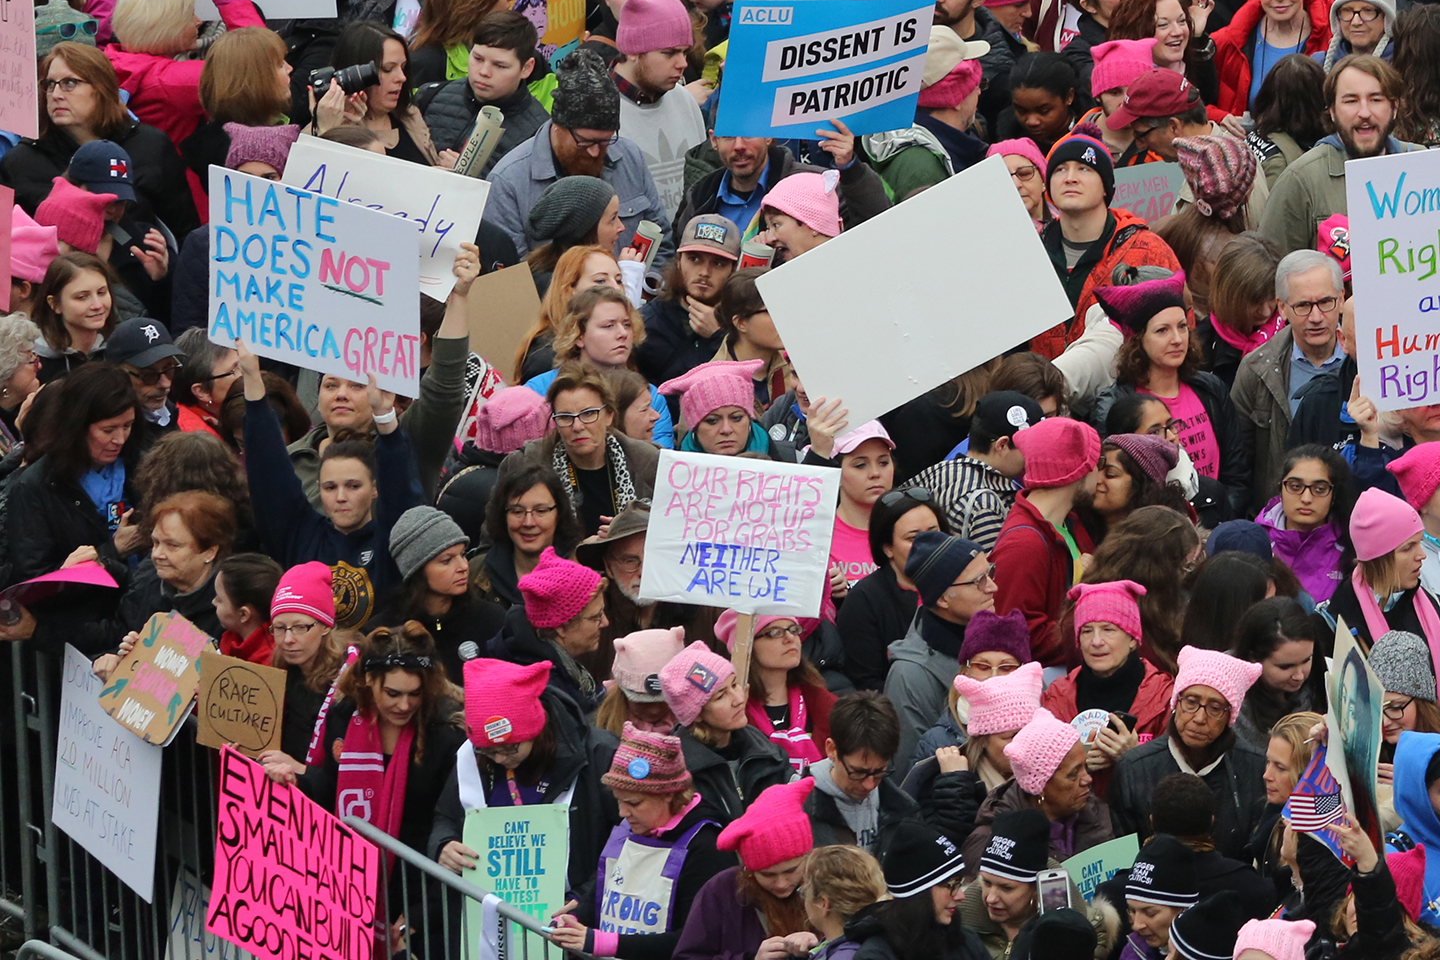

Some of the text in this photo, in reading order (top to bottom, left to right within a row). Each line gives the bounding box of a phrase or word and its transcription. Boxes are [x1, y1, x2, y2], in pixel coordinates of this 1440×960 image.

[742, 9, 790, 23] ACLU
[780, 18, 917, 71] DISSENT IS
[789, 65, 909, 116] PATRIOTIC
[224, 175, 339, 243] HATE
[213, 225, 390, 296] DOES NOT
[216, 270, 305, 311] MAKE
[210, 302, 419, 379] AMERICA GREAT
[668, 461, 823, 507] OUR RIGHTS
[664, 491, 781, 526] ARE NOT
[682, 518, 812, 552] FOR GRABS
[680, 541, 780, 574] NEITHER
[686, 569, 741, 596] ARE
[153, 645, 190, 678] WOMEN
[219, 677, 260, 706] RAPE
[116, 697, 156, 732] WOMEN
[209, 702, 272, 733] CULTURE
[488, 834, 546, 849] BELIEVE WE
[504, 821, 530, 834] CANT
[487, 847, 545, 877] STILL
